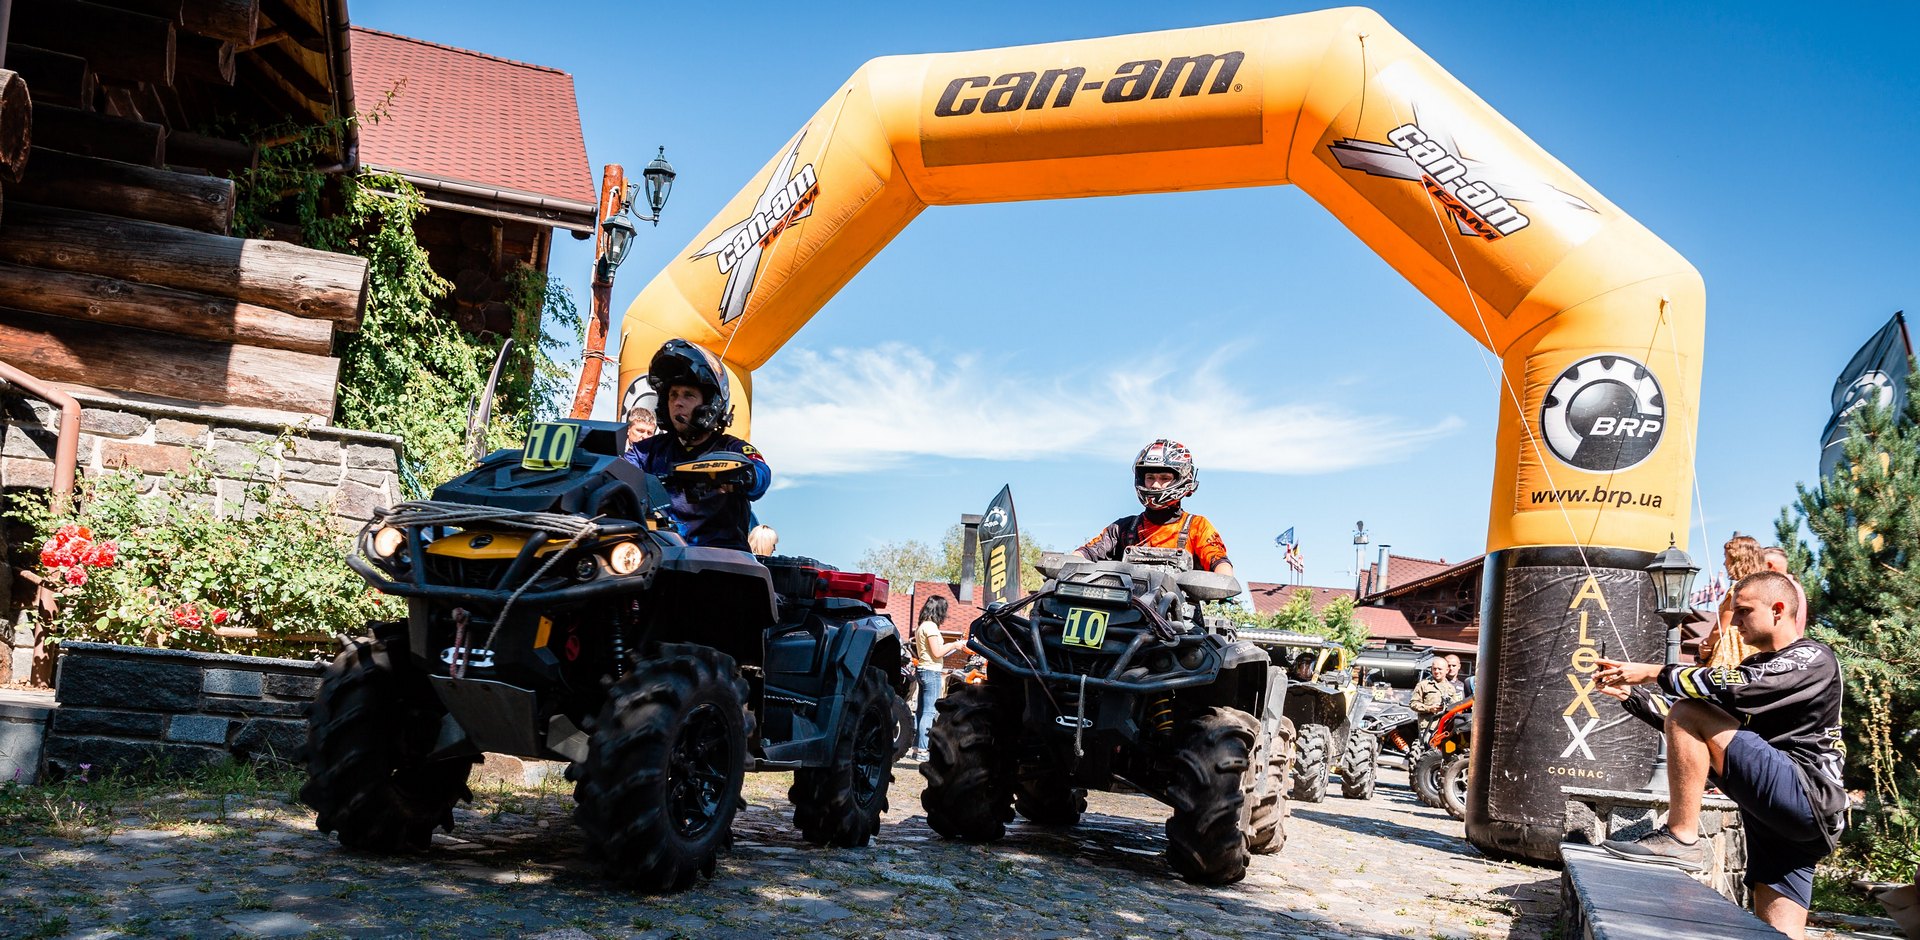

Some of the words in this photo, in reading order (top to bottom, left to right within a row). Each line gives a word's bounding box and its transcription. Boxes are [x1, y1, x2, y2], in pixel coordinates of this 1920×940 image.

[934, 50, 1245, 117] can-am
[1386, 122, 1531, 237] can-am
[716, 163, 818, 275] can-am
[759, 184, 820, 248] TEAM
[1420, 174, 1501, 242] TEAM
[525, 424, 574, 468] 10
[1589, 416, 1661, 438] BRP
[1531, 485, 1662, 508] www.brp.ua
[1064, 610, 1105, 646] 10
[1548, 766, 1604, 779] COGNAC
